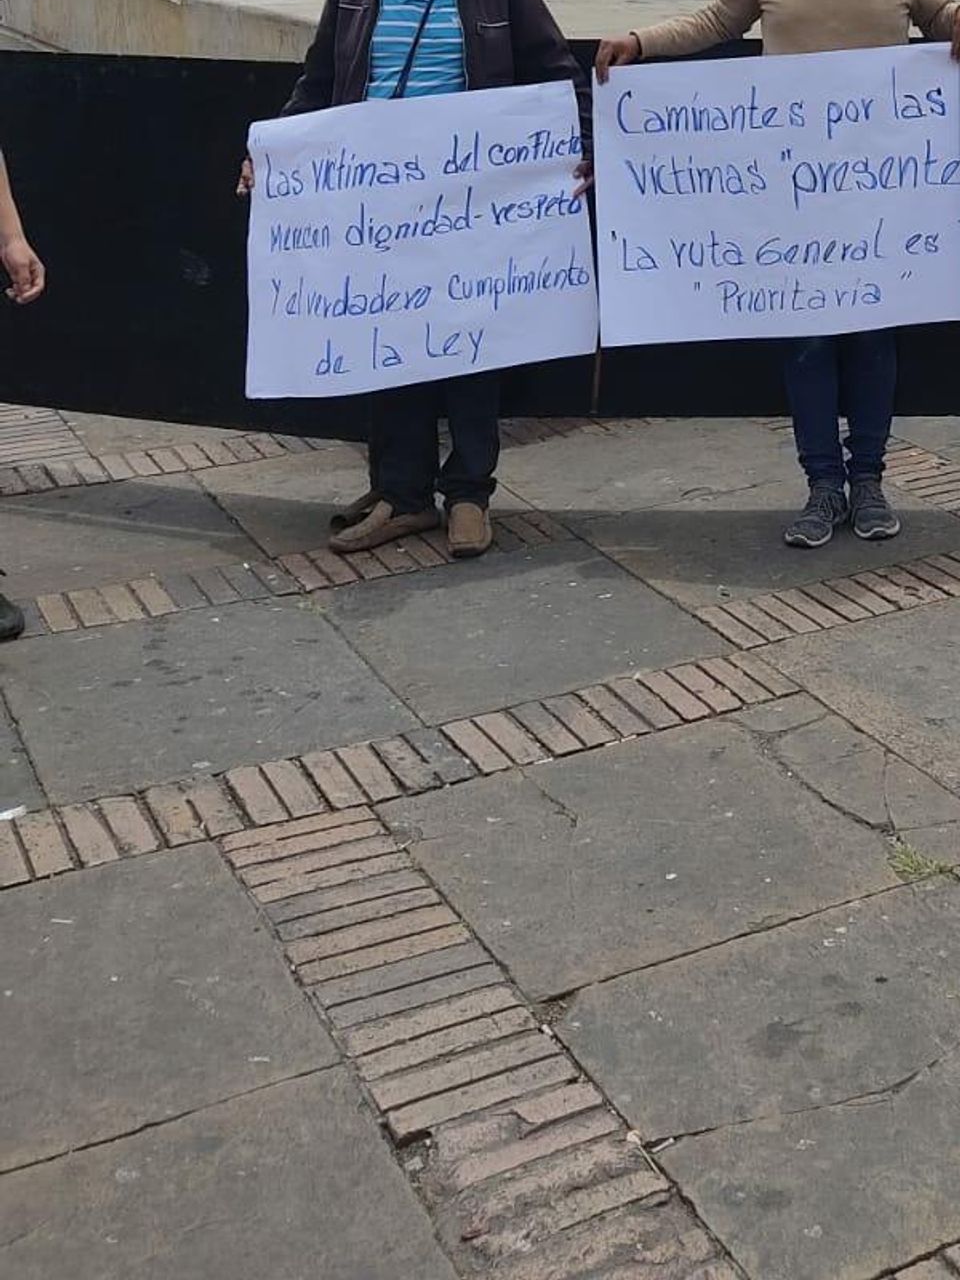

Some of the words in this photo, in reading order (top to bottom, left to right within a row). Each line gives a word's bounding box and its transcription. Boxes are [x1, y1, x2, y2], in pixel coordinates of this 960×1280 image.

[827, 98, 874, 140] por
[891, 67, 947, 120] las
[443, 130, 479, 175] del
[670, 230, 745, 269] ruta
[905, 232, 939, 256] es
[315, 338, 350, 376] de
[373, 326, 403, 370] la
